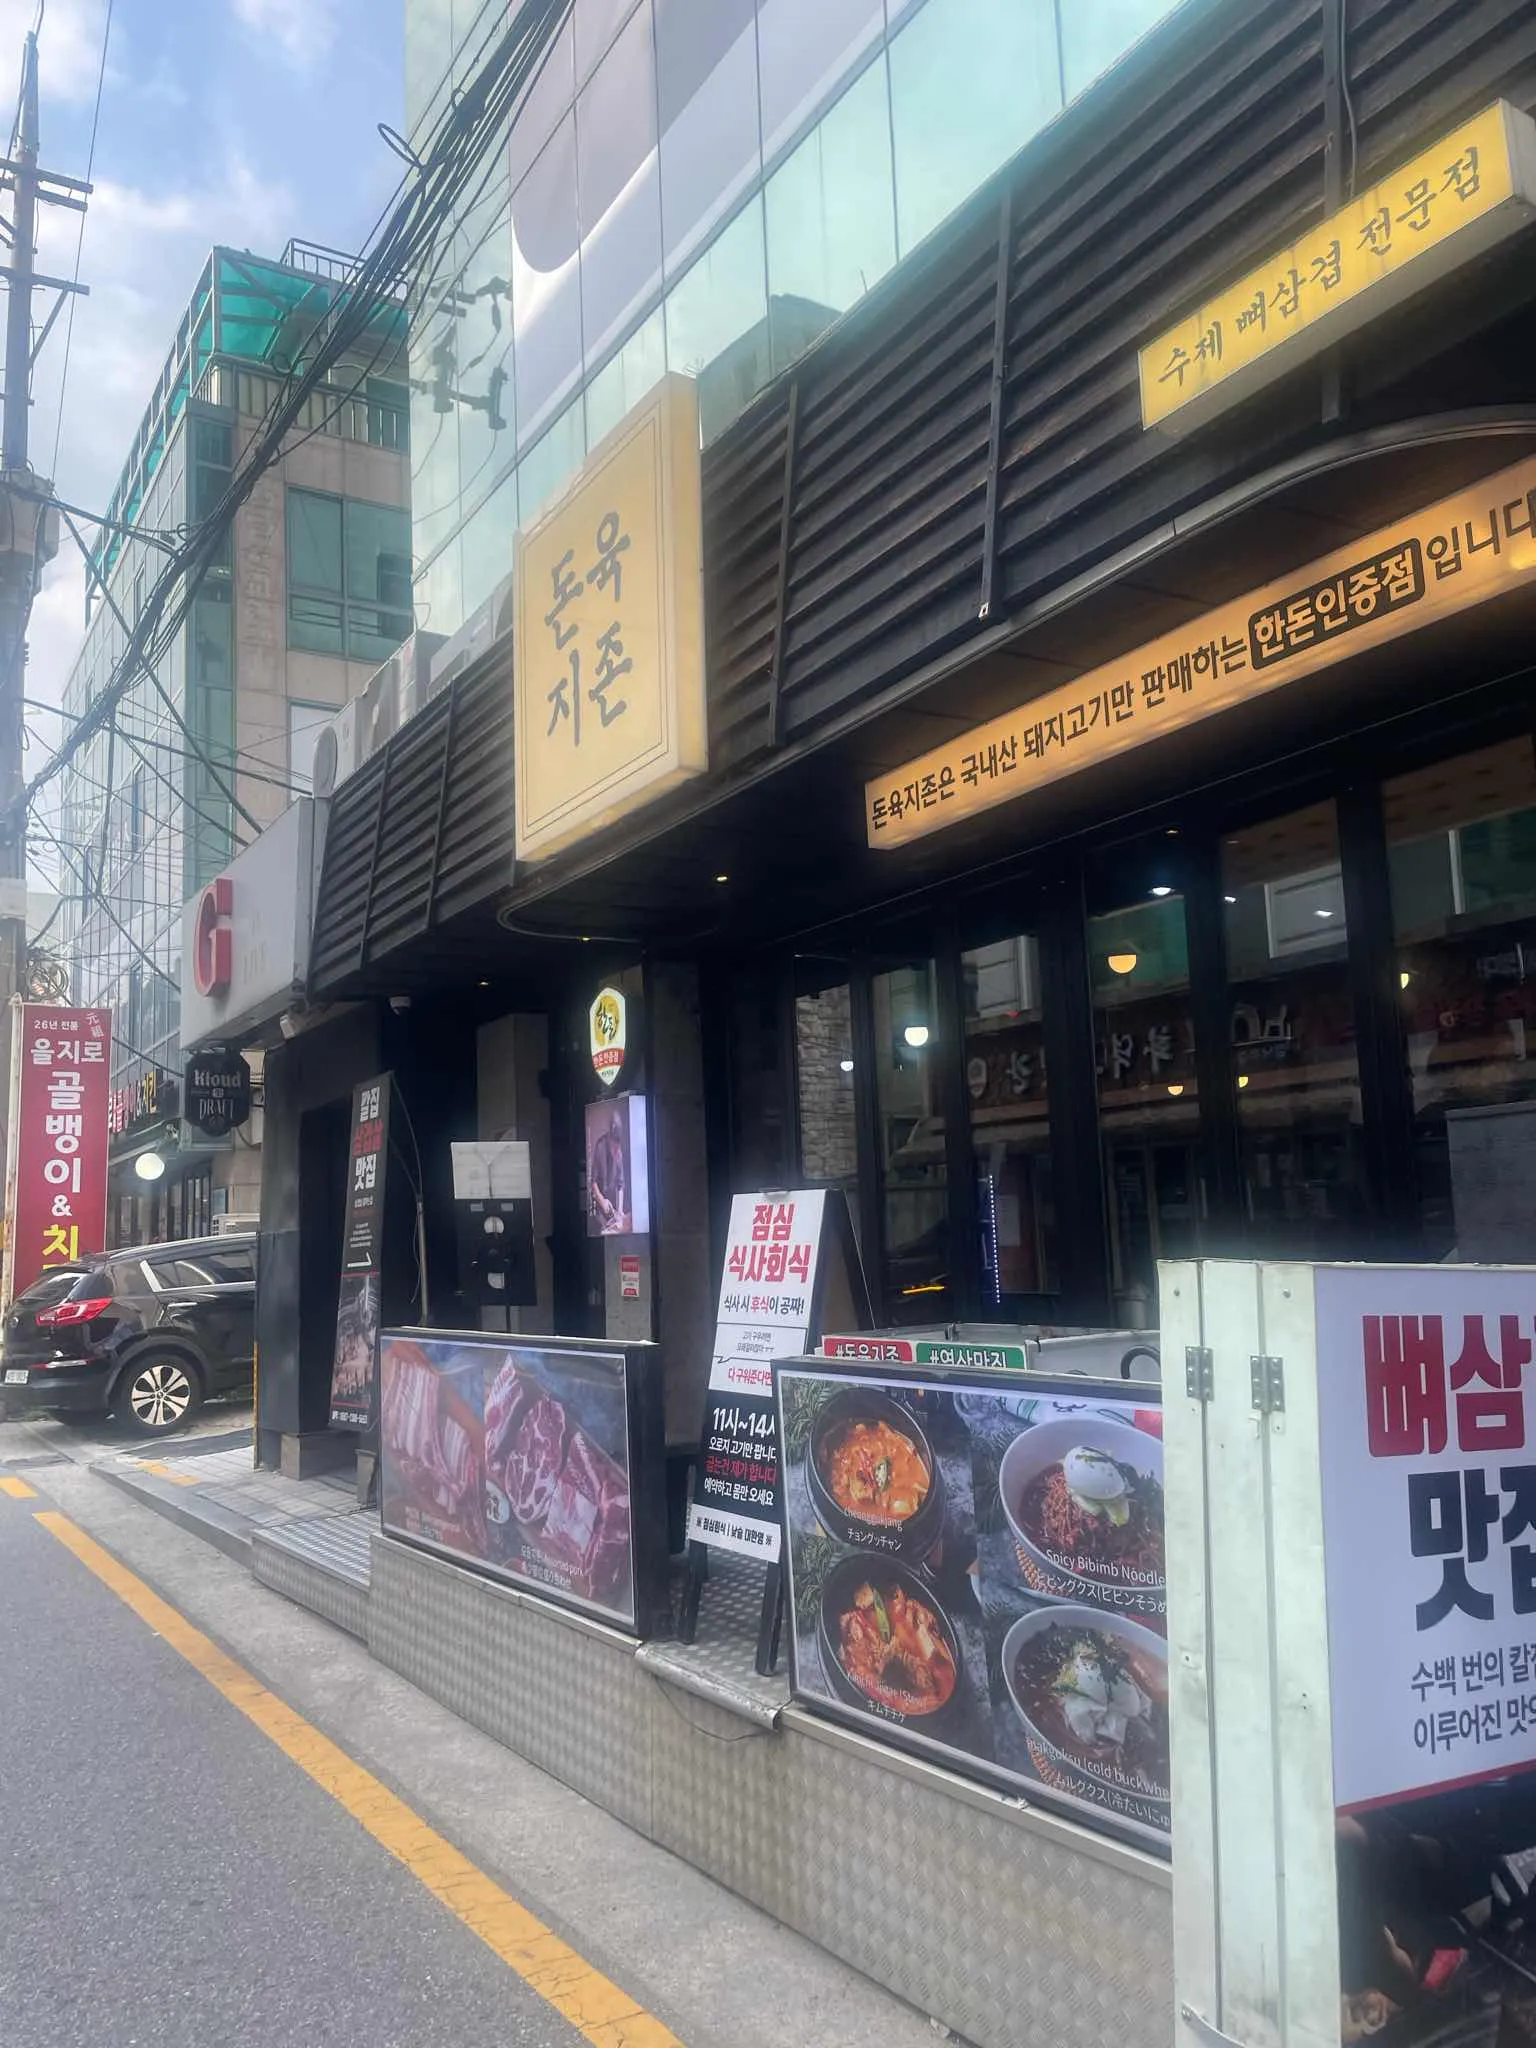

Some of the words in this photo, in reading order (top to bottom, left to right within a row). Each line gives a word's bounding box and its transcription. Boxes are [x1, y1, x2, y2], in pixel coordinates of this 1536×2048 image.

[1158, 322, 1223, 387] 수제
[1235, 240, 1342, 333] 뼈삼겹
[1356, 147, 1481, 257] 전문점
[545, 511, 631, 651] 돈육
[872, 766, 956, 831] 돈육지존은
[960, 735, 1018, 787] 국내산
[1023, 680, 1135, 759] 돼지고기만
[1141, 635, 1247, 710] 판매하는
[1253, 547, 1415, 660] 한돈인증점
[1426, 487, 1536, 581] 입니다
[547, 621, 633, 748] 지존
[34, 1019, 58, 1031] 26년
[31, 1038, 105, 1065] 을지로
[194, 1069, 241, 1088] Kloud
[44, 1070, 85, 1193] 골뱅이
[51, 1194, 72, 1217] &
[752, 1203, 795, 1242] 점심
[42, 1224, 79, 1271] 치
[728, 1243, 812, 1284] 식사회식
[724, 1295, 740, 1313] 식사
[1362, 1315, 1536, 1458] 뼈삼
[731, 1440, 754, 1459] 고기만
[704, 1477, 732, 1497] 예약하고
[732, 1482, 749, 1500] 몸만
[749, 1487, 774, 1506] 오세요
[1046, 1549, 1075, 1570] Spicy
[1077, 1555, 1118, 1577] Bibimb
[1411, 1656, 1456, 1702] 수백
[1462, 1648, 1504, 1692] 번의
[1509, 1643, 1536, 1683] 칼
[1414, 1700, 1503, 1754] 이루어진
